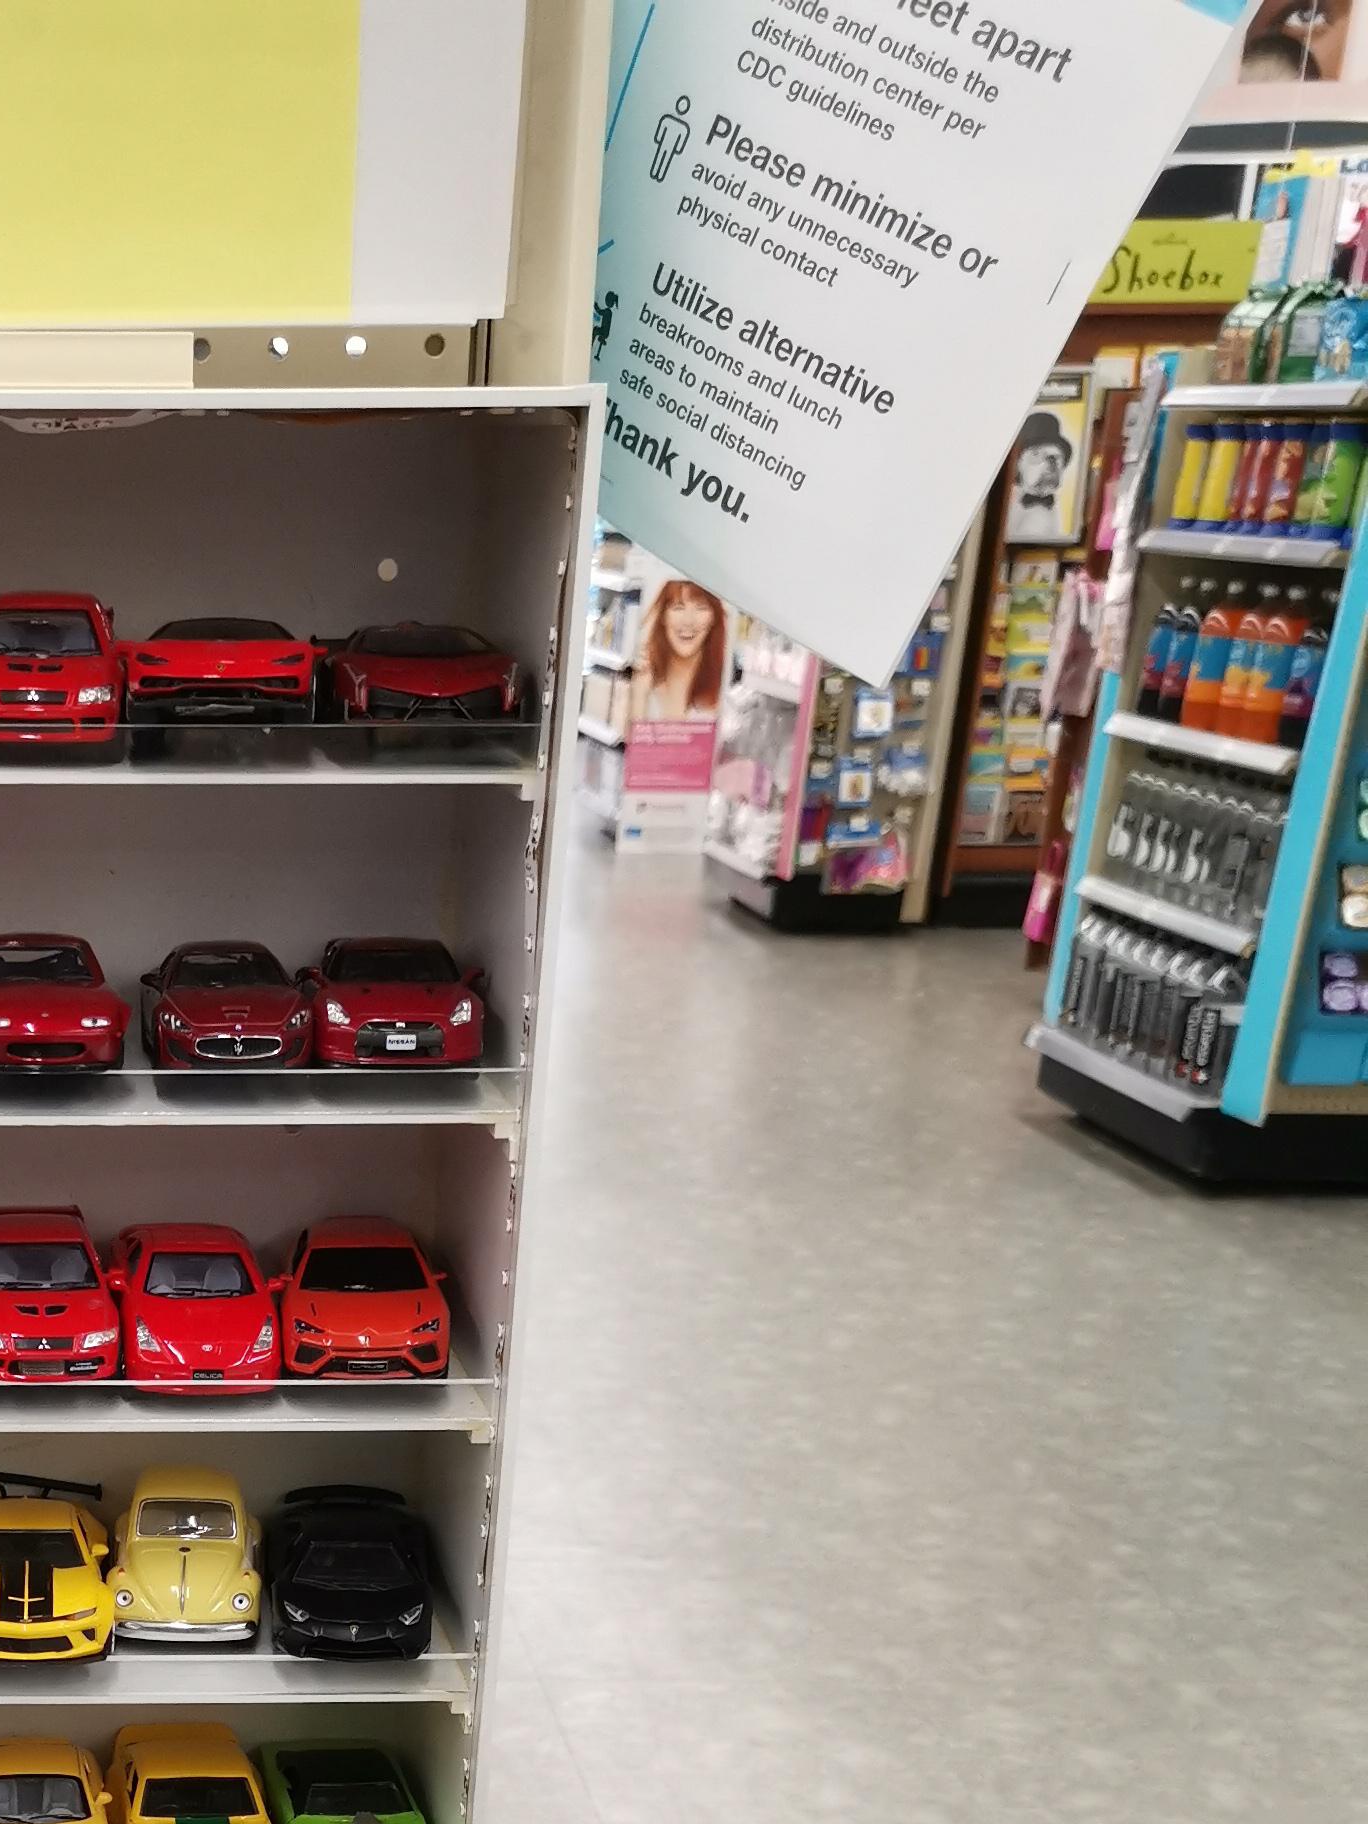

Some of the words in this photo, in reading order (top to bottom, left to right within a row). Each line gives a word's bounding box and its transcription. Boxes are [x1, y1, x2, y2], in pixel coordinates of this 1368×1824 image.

[736, 50, 787, 88] CDC
[786, 79, 895, 141] guidelines
[751, 17, 869, 86] distribution
[873, 76, 944, 120] center
[942, 109, 986, 139] per
[832, 15, 877, 46] and
[878, 36, 958, 84] outside
[964, 69, 999, 102] the
[972, 18, 1072, 83] apart
[677, 194, 761, 248] physical
[760, 237, 839, 288] contact
[691, 161, 747, 201] avoid
[747, 190, 786, 223] any
[787, 209, 919, 289] unnecessary
[704, 114, 806, 188] Please
[810, 172, 953, 259] minimize
[958, 247, 999, 279] or
[1102, 246, 1224, 295] Shoebox
[629, 338, 675, 376] areas
[678, 364, 696, 388] to
[699, 380, 779, 435] maintain
[639, 302, 744, 377] breakrooms
[747, 369, 787, 399] and
[787, 385, 842, 430] lunch
[652, 262, 734, 331] Utilize
[738, 319, 895, 414] alternative
[604, 397, 679, 479] hank
[680, 461, 749, 523] you.
[619, 368, 654, 400] safe
[655, 391, 709, 433] social
[710, 422, 806, 491] distancing
